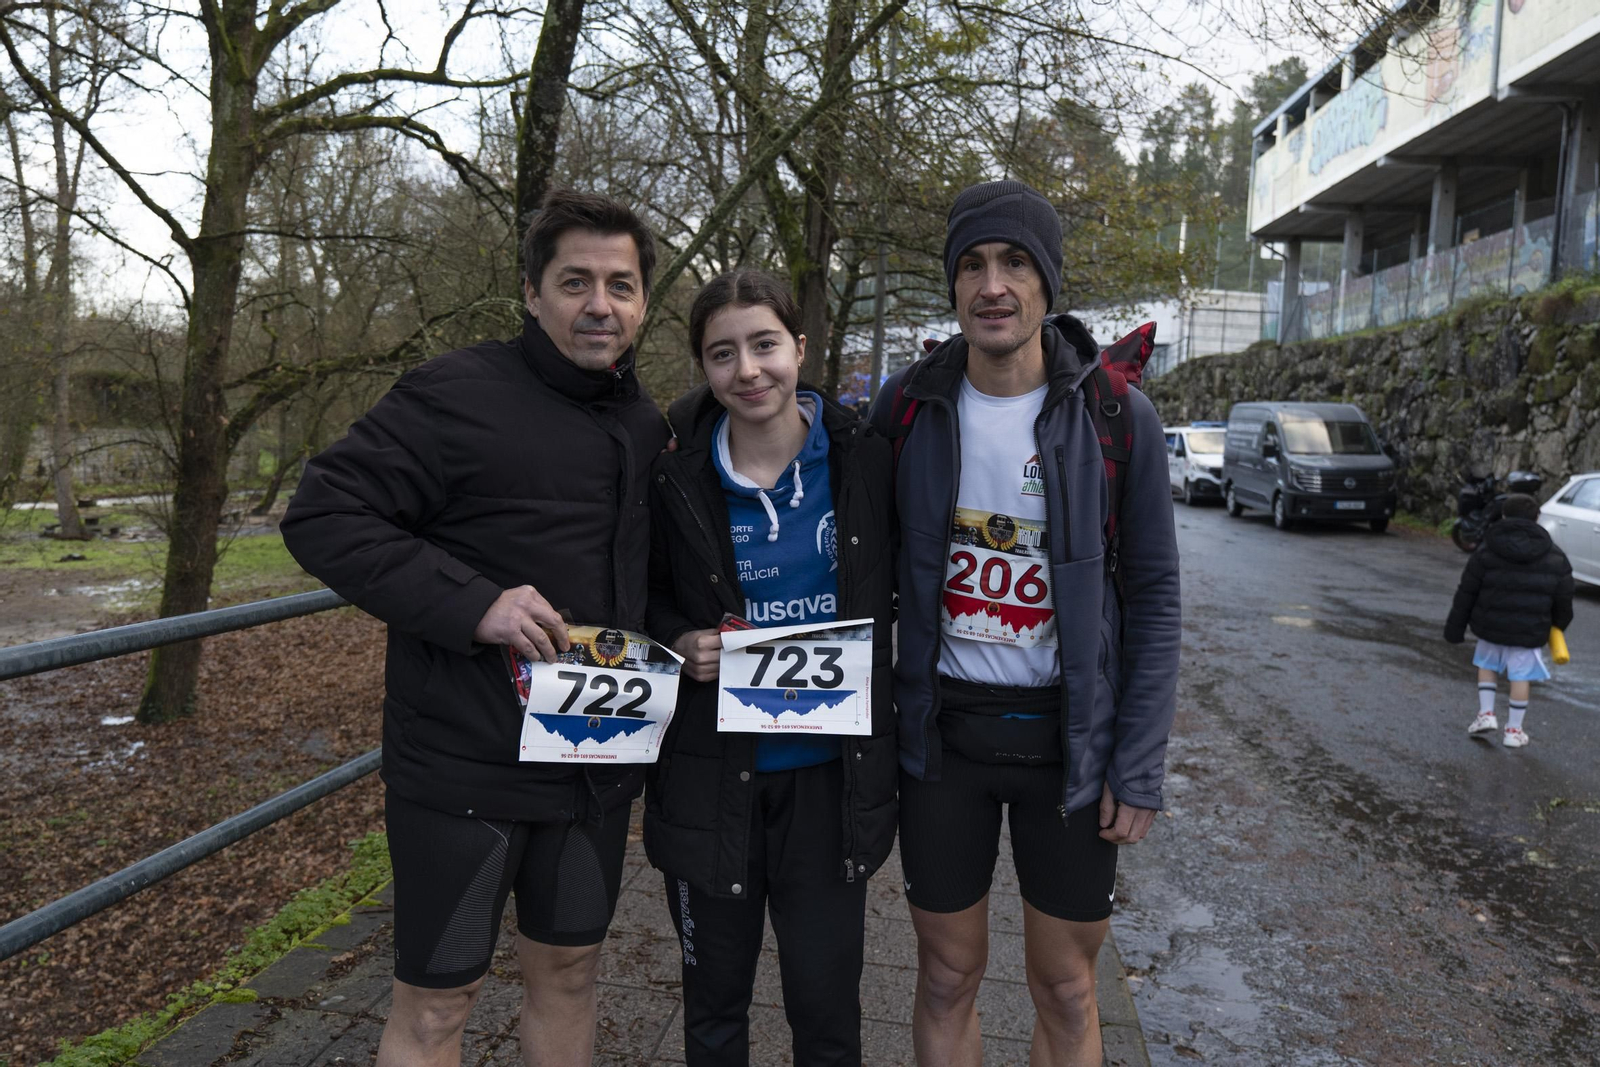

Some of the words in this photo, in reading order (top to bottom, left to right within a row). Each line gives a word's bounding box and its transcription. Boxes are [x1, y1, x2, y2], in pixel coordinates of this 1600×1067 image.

[729, 525, 754, 534] ORTE
[730, 534, 750, 544] EGO
[736, 559, 752, 571] TA
[738, 566, 779, 582] ALICIA
[947, 550, 1048, 604] 206
[745, 646, 845, 689] 723
[557, 670, 652, 718] 722
